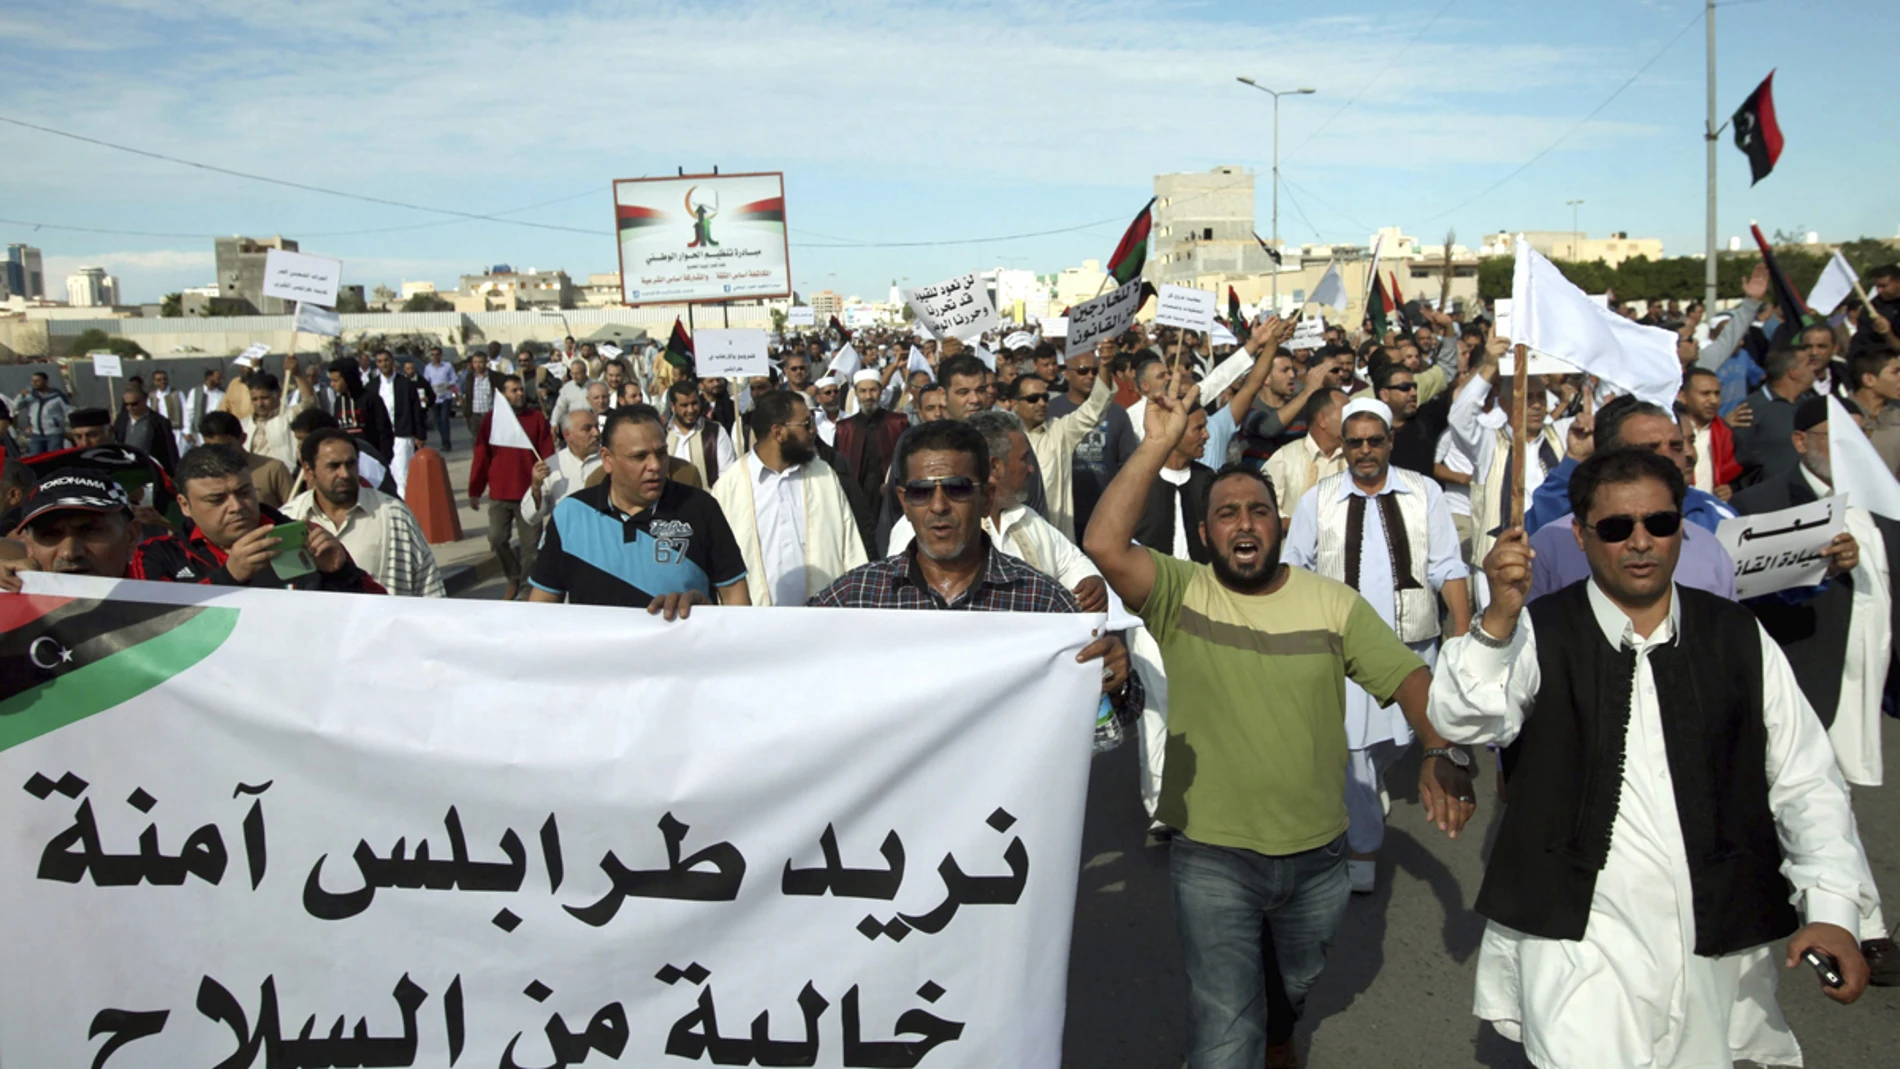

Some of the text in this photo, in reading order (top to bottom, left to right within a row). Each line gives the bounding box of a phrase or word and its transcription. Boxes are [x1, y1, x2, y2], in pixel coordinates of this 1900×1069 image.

[645, 248, 762, 265] مبادرة تنظيم الحوار الوطني
[941, 278, 962, 297] نعود
[963, 274, 975, 291] لن
[926, 292, 974, 318] قد تحررنا
[1073, 285, 1130, 323] للخارجين
[1072, 312, 1122, 345] القانون
[39, 476, 107, 492] YOKOHAMA
[1738, 503, 1832, 547] نعم
[654, 537, 690, 565] 67
[24, 772, 1028, 942] نريد طرابلس آمنة
[89, 973, 465, 1069] السلاح
[498, 980, 629, 1069] من
